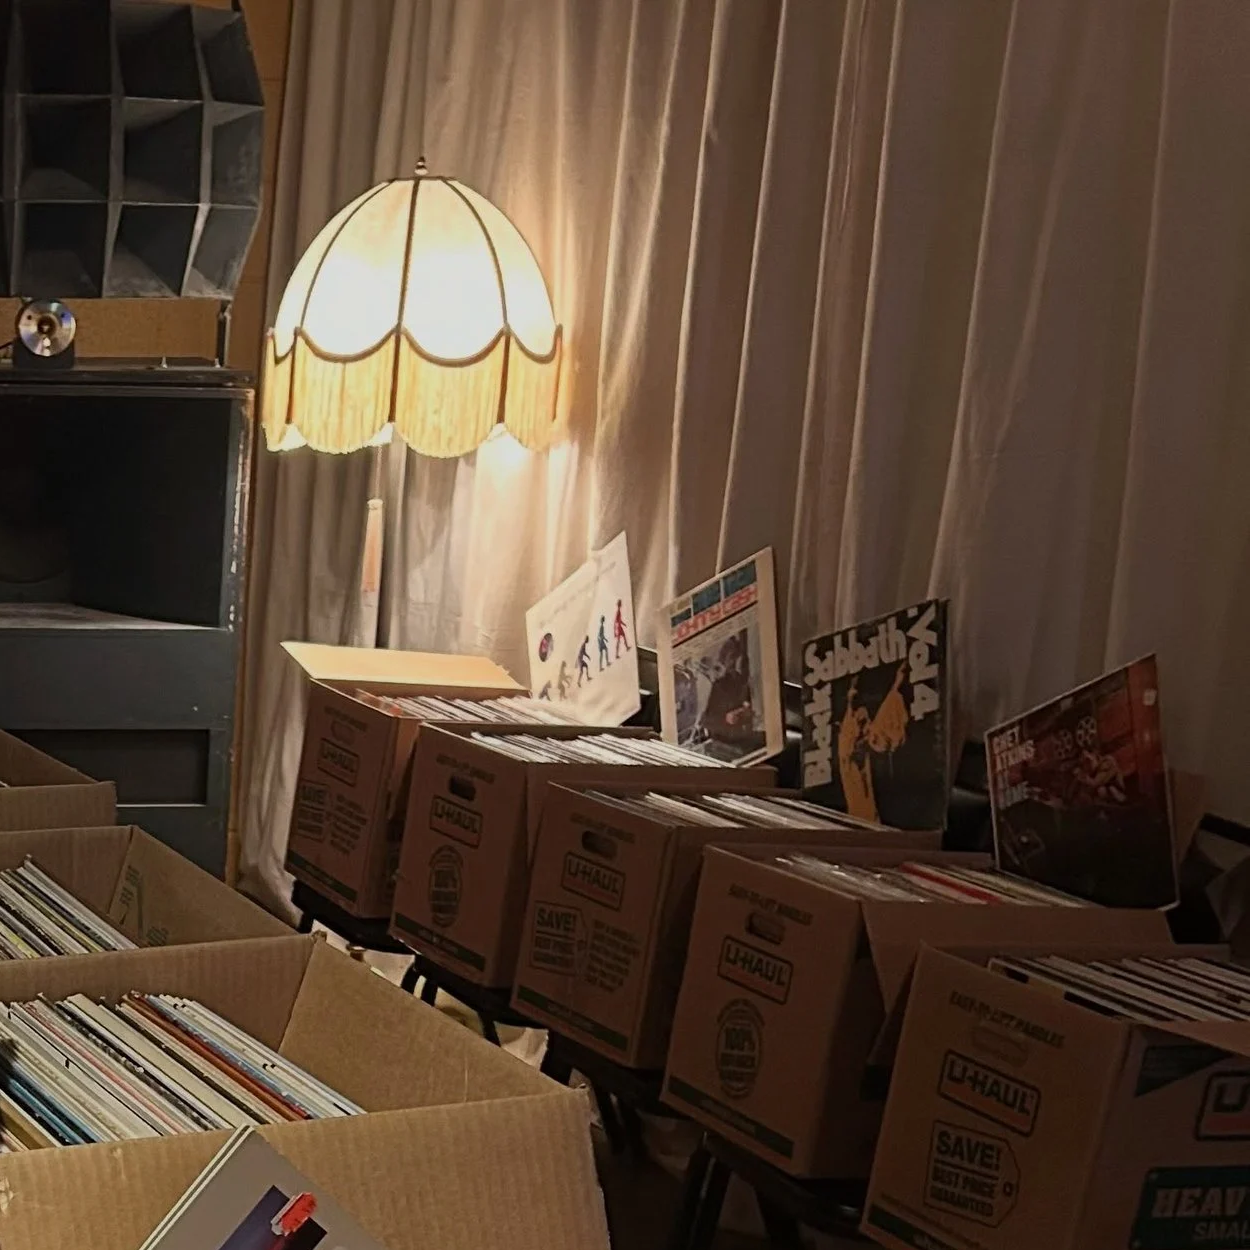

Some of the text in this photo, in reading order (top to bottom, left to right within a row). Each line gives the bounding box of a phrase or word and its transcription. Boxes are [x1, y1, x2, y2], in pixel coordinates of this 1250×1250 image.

[804, 617, 908, 686] Sabbath
[910, 683, 939, 722] 4
[804, 683, 832, 788] Black
[568, 858, 618, 894] U-HAUL
[725, 944, 787, 986] U-HAUL
[948, 1060, 1030, 1116] U-HAUL
[936, 1131, 1000, 1171] SAVE!
